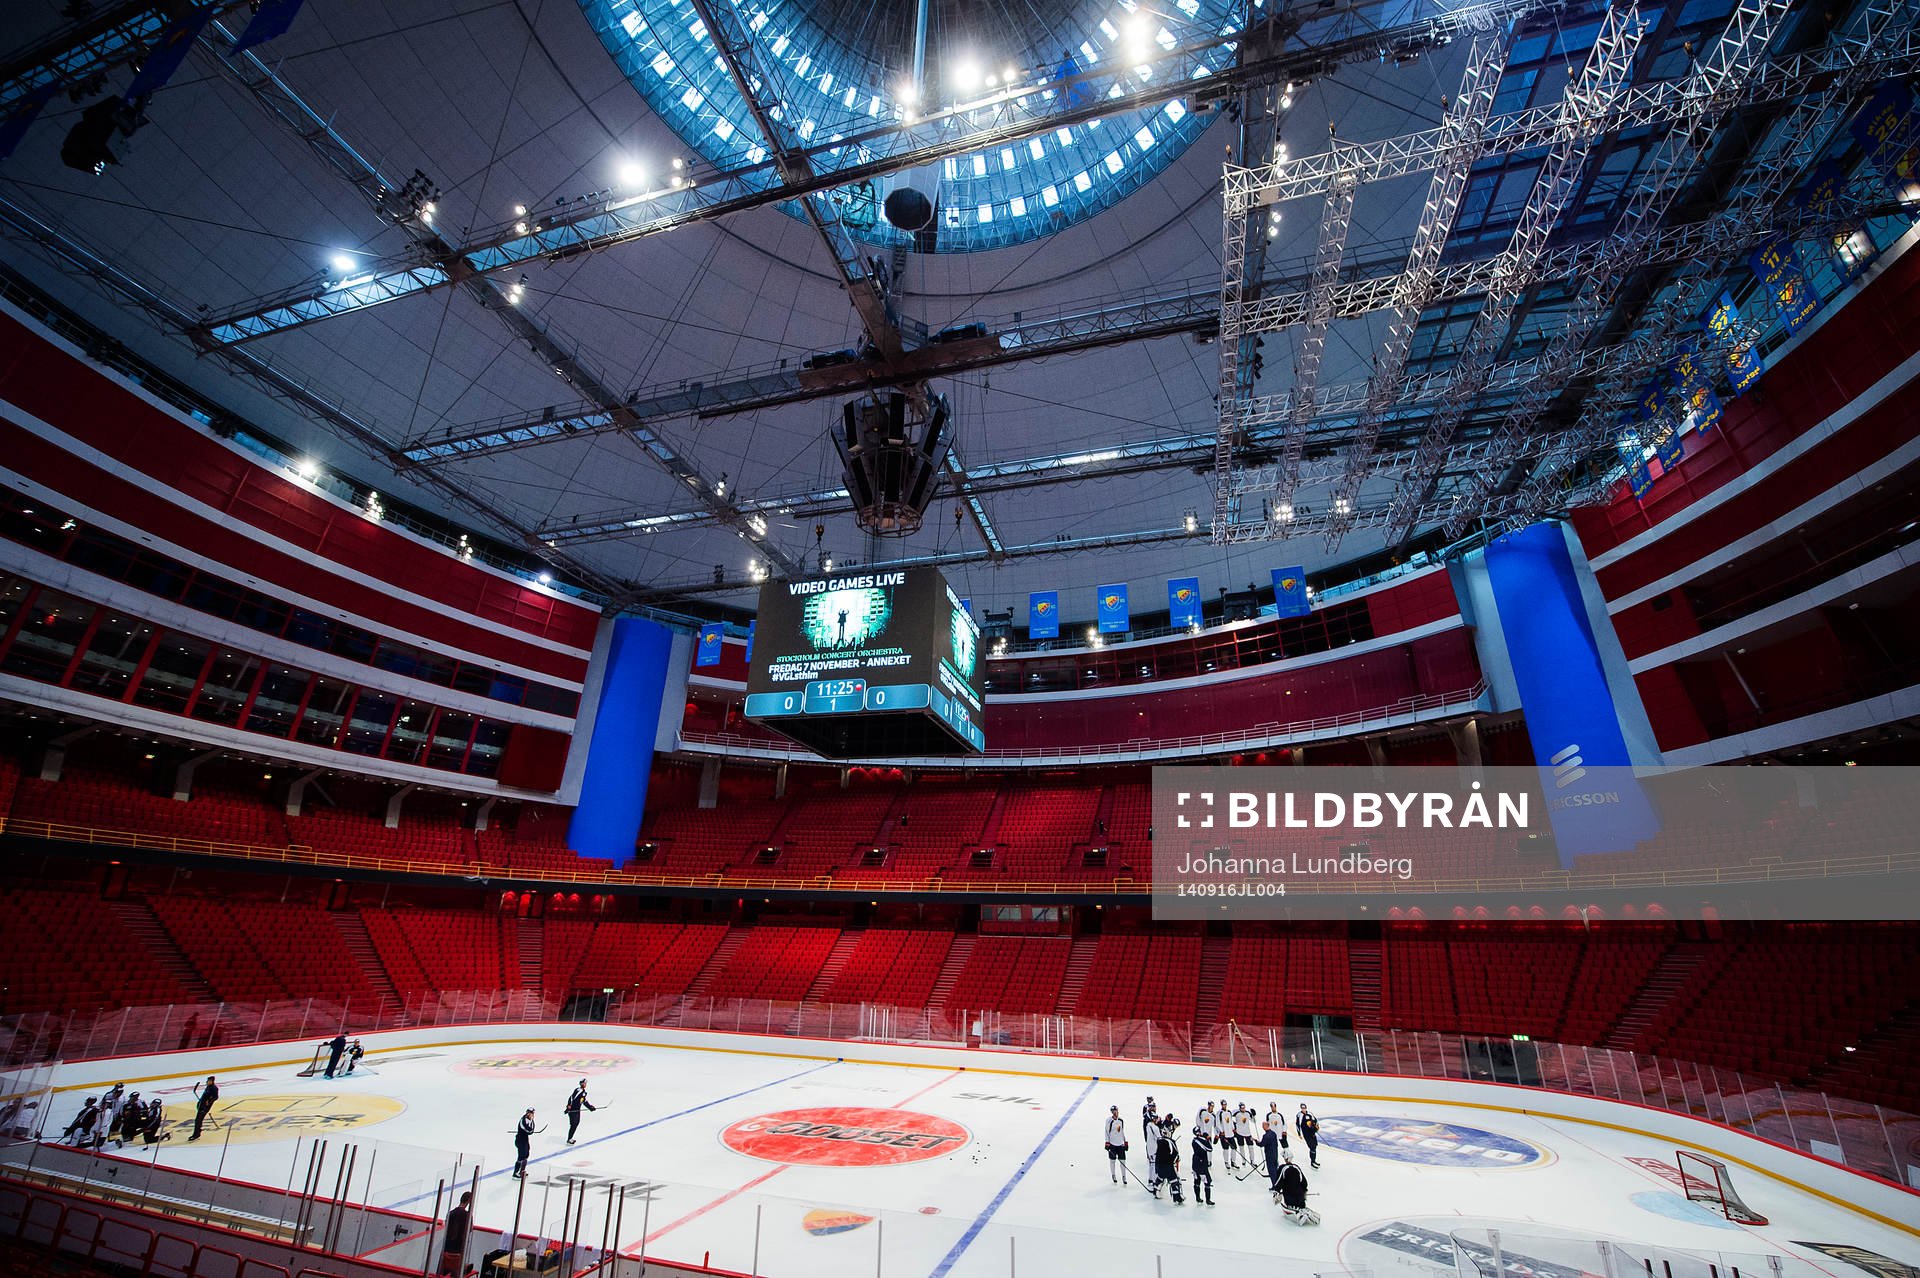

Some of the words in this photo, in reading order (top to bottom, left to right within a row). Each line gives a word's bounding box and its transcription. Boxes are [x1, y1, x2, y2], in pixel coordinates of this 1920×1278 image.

[1766, 251, 1780, 269] 11
[1680, 361, 1693, 377] 12
[789, 581, 826, 595] VIDEO
[828, 576, 874, 592] GAMES
[876, 572, 905, 586] LIVE
[768, 664, 802, 674] FREDAG
[803, 663, 809, 672] 7
[810, 659, 860, 670] NOVEMBER
[867, 655, 912, 667] ANNEXET
[776, 653, 820, 663] STOCKHOLM
[821, 650, 857, 660] CONCERT
[857, 648, 903, 657] ORCHESTRA
[816, 681, 854, 697] 11:25
[784, 697, 793, 710] 0
[830, 698, 836, 711] 1
[876, 691, 885, 705] 0
[952, 1092, 1041, 1105] SHL
[766, 1121, 962, 1149] ODDSET
